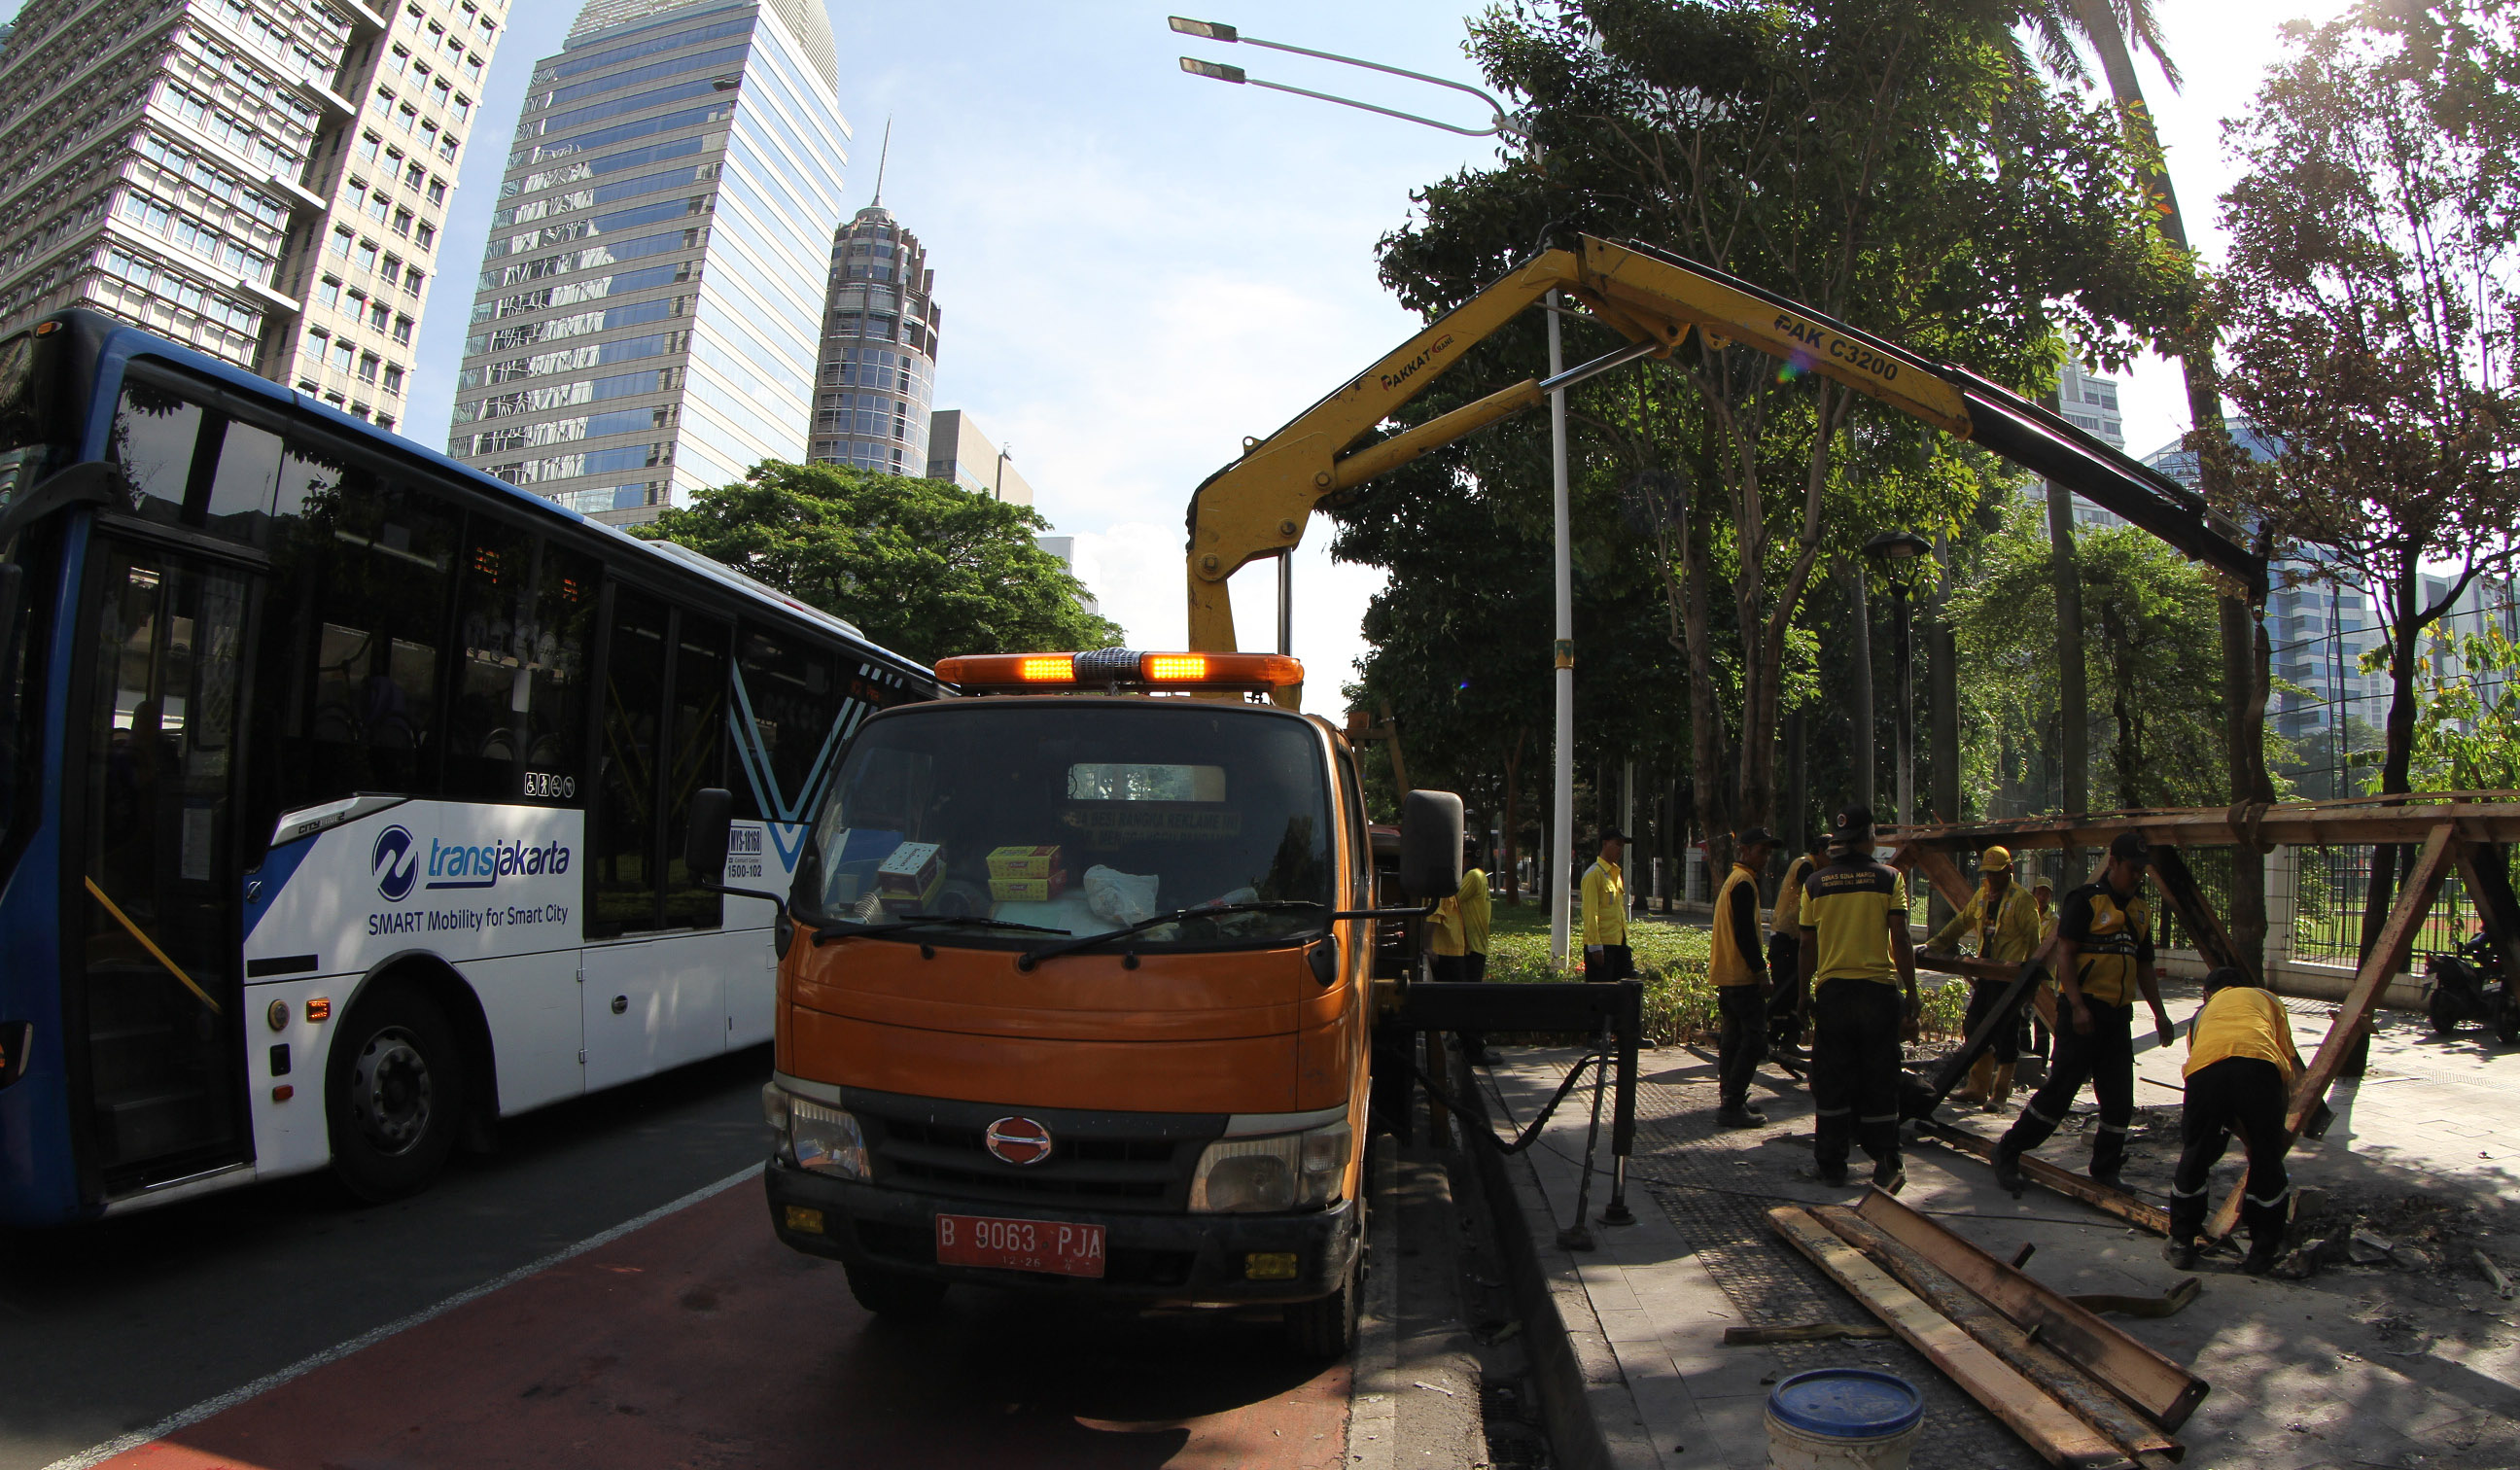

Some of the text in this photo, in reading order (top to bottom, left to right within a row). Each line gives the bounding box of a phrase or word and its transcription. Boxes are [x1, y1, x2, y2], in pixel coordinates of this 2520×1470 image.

[1381, 333, 1454, 392] PAKKAT CRANE
[1773, 314, 1899, 381] PAK C3200
[425, 837, 571, 890] transjakarta
[728, 864, 762, 878] 1500-102
[368, 904, 569, 935] SMART Mobility for Smart City
[941, 1217, 1102, 1259] B 9063 PJA
